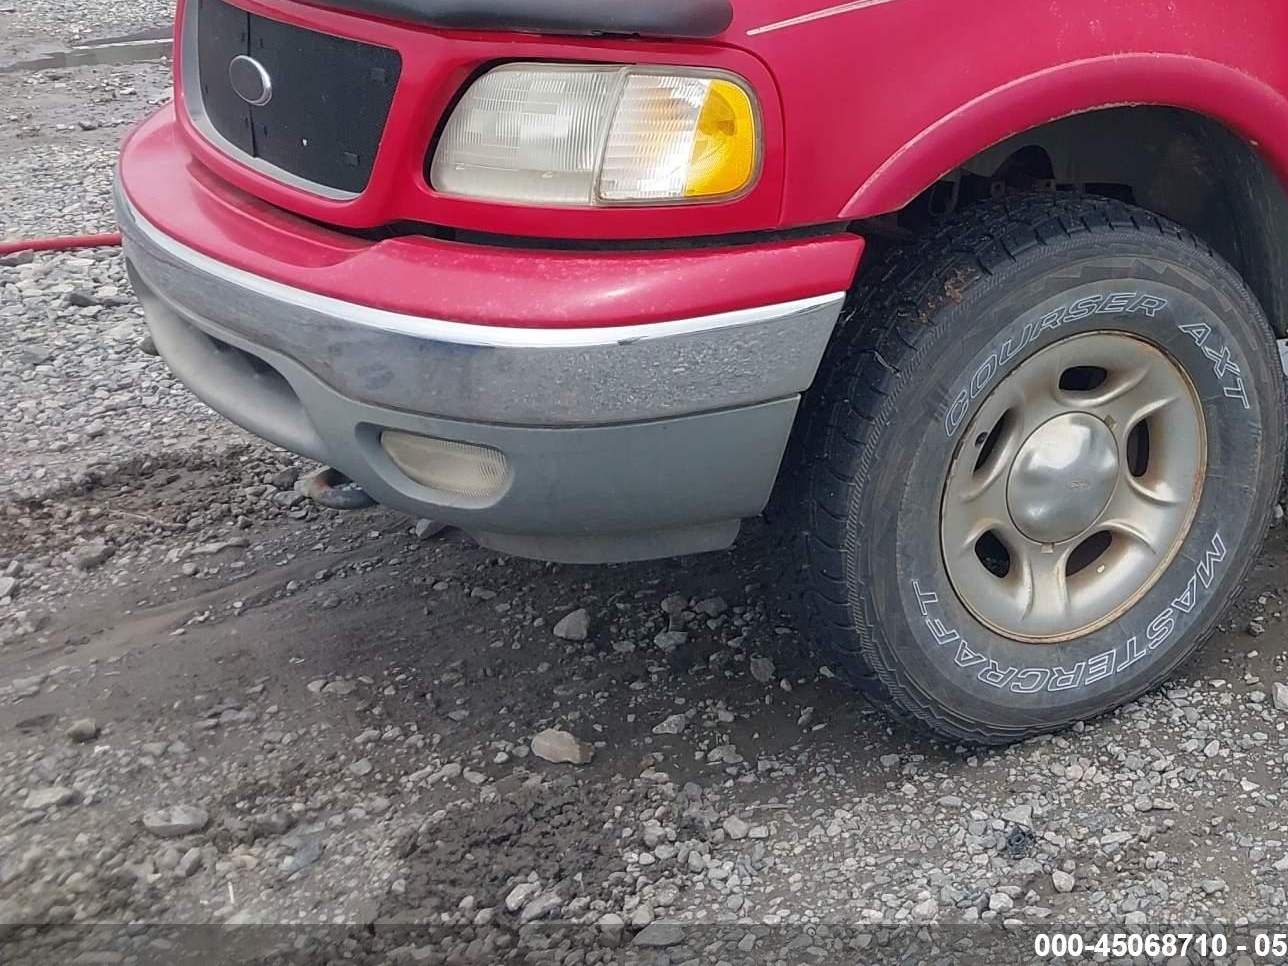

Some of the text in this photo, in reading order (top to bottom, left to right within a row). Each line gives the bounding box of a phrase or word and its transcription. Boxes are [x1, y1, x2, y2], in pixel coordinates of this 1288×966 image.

[943, 291, 1252, 439] COURSER AXT
[910, 531, 1228, 694] MASTERCRAFT
